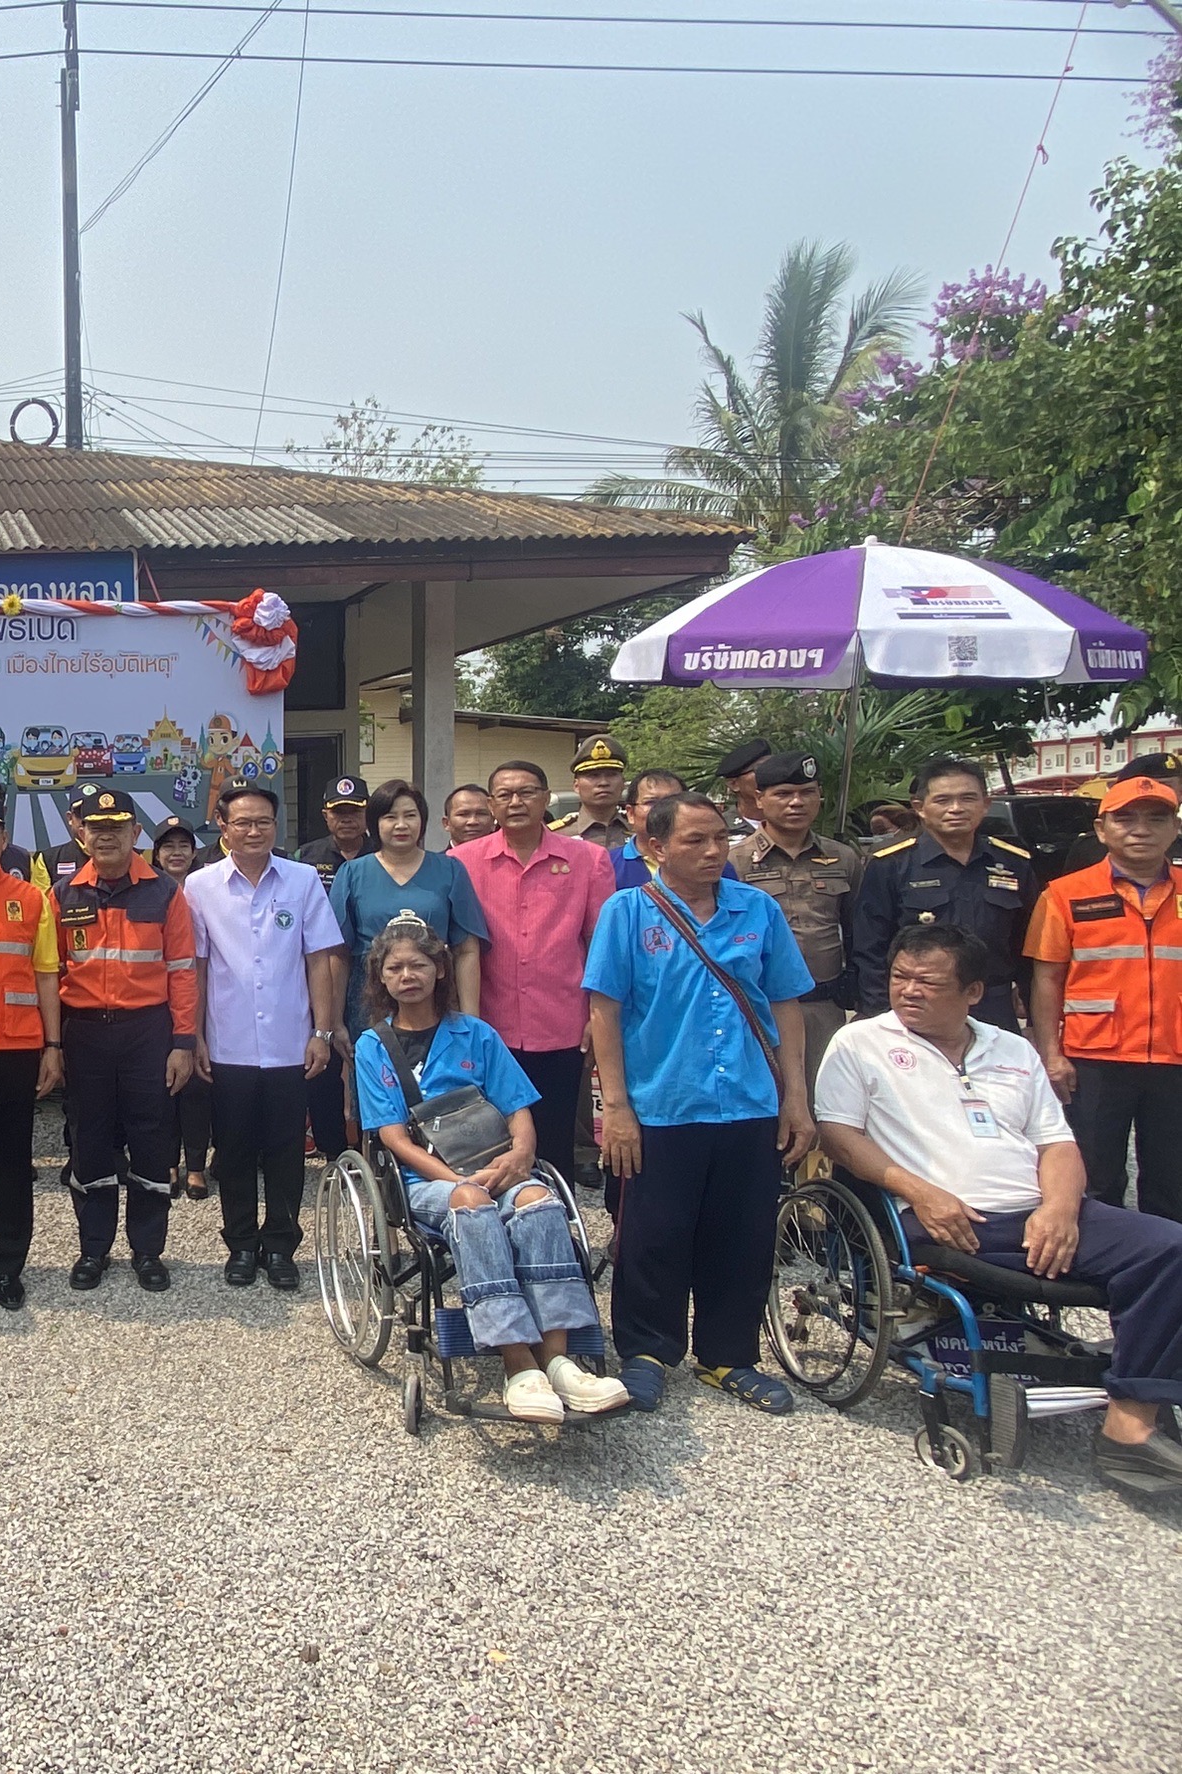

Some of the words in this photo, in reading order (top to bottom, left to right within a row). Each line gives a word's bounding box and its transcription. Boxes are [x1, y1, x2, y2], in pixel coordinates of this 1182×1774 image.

[683, 643, 825, 671] บริษัทกลางฯ
